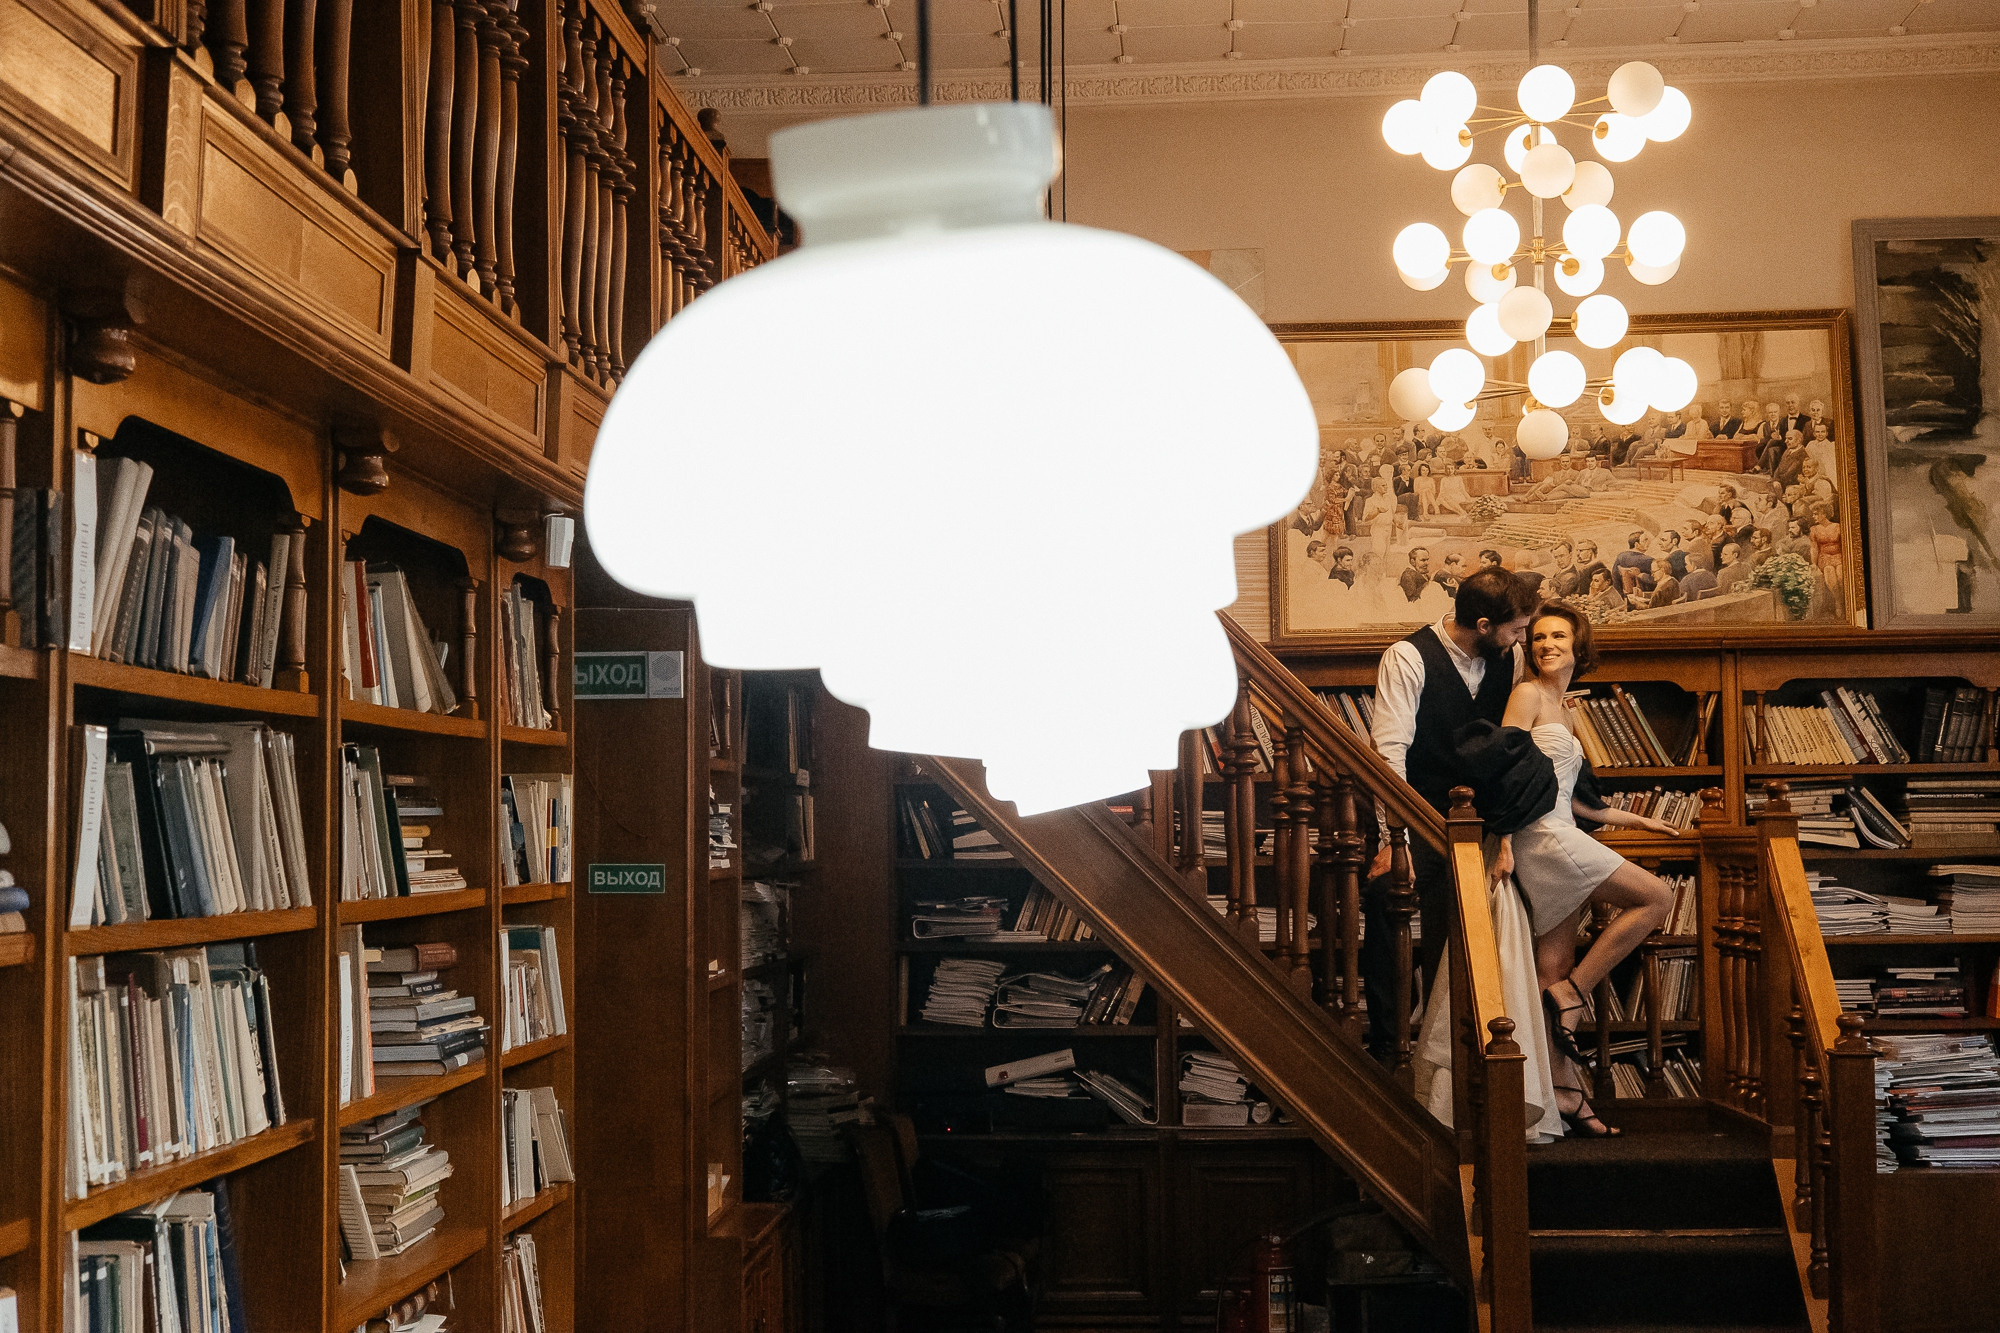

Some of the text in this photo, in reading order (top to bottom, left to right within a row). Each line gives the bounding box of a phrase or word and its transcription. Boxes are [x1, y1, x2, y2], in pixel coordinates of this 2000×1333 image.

[574, 663, 644, 689] ЫХОД
[1869, 738, 1886, 763] SCARPA
[594, 871, 661, 888] ВЫХОД
